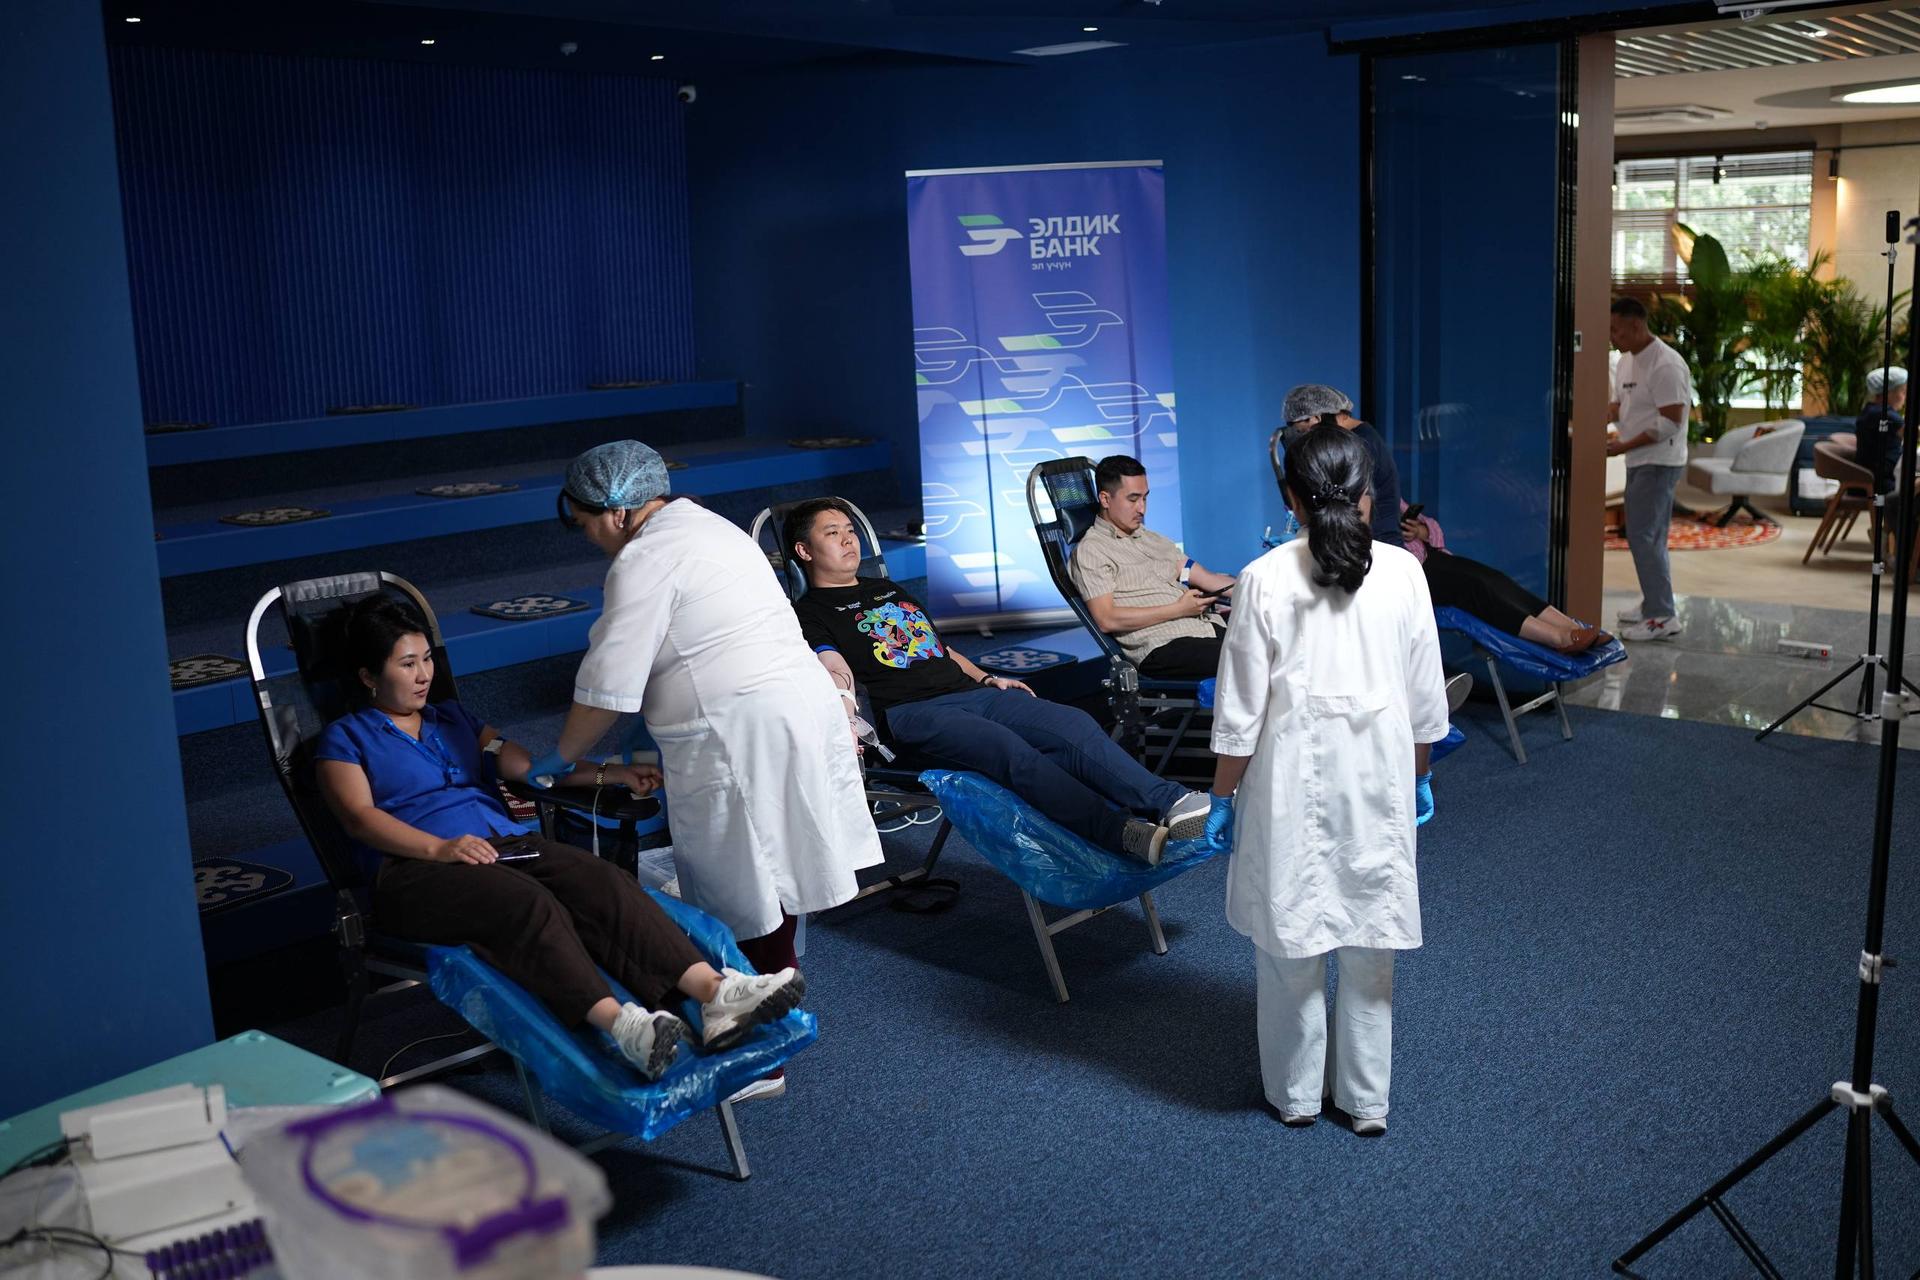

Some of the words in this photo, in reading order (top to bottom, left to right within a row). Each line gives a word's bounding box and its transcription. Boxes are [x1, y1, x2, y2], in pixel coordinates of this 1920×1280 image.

[1028, 213, 1121, 238] ЭЛДИК
[1030, 235, 1101, 259] БАНК
[1031, 262, 1045, 271] эл
